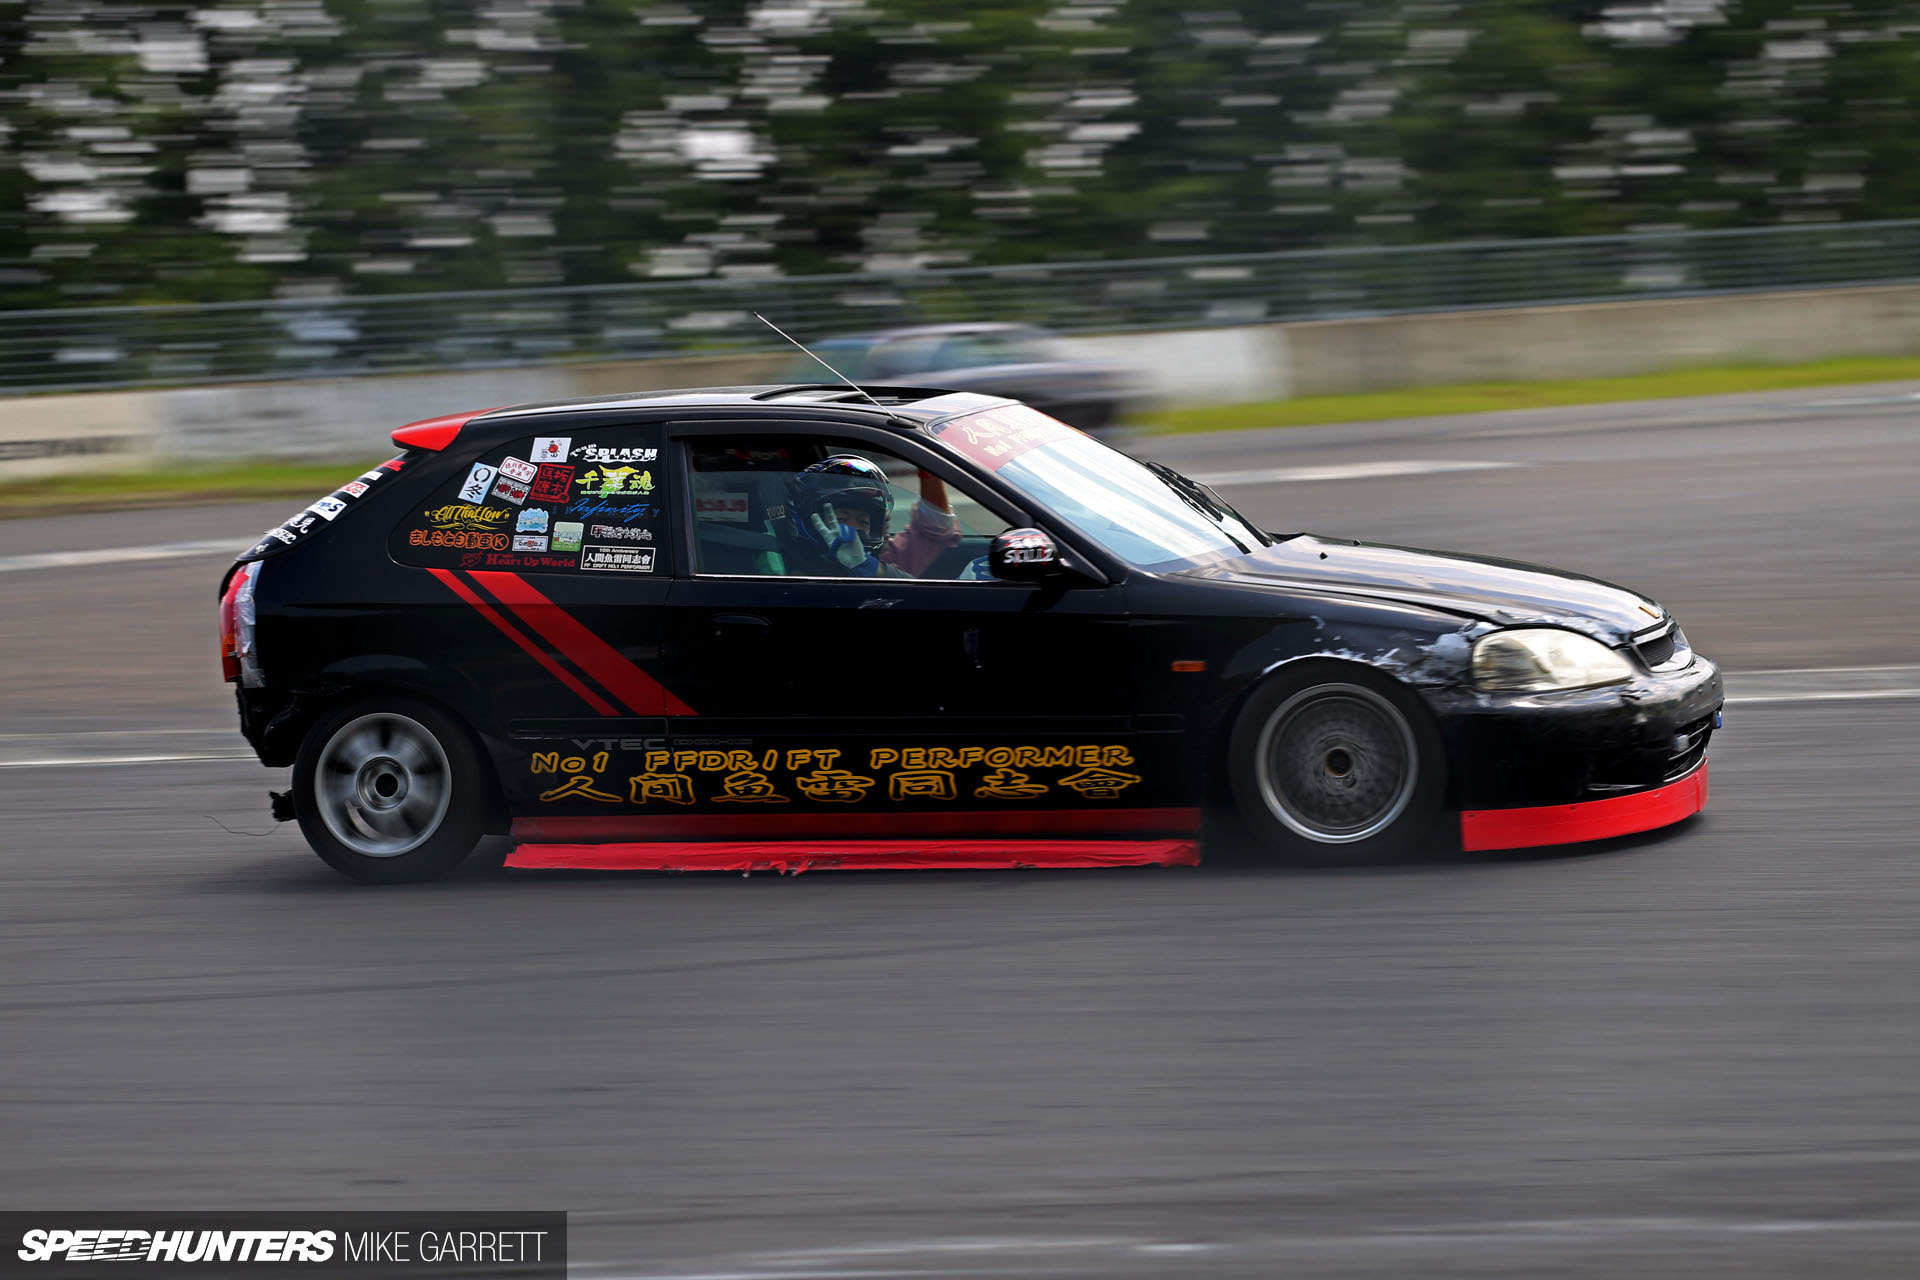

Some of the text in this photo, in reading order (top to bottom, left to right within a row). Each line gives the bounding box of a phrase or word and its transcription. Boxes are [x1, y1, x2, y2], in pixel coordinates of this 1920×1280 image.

[569, 443, 597, 457] Team
[583, 448, 657, 463] SPLASH
[486, 554, 576, 568] Heart Up World
[570, 738, 666, 751] VTEC
[530, 751, 609, 774] No1
[870, 745, 1135, 769] PERFORMER
